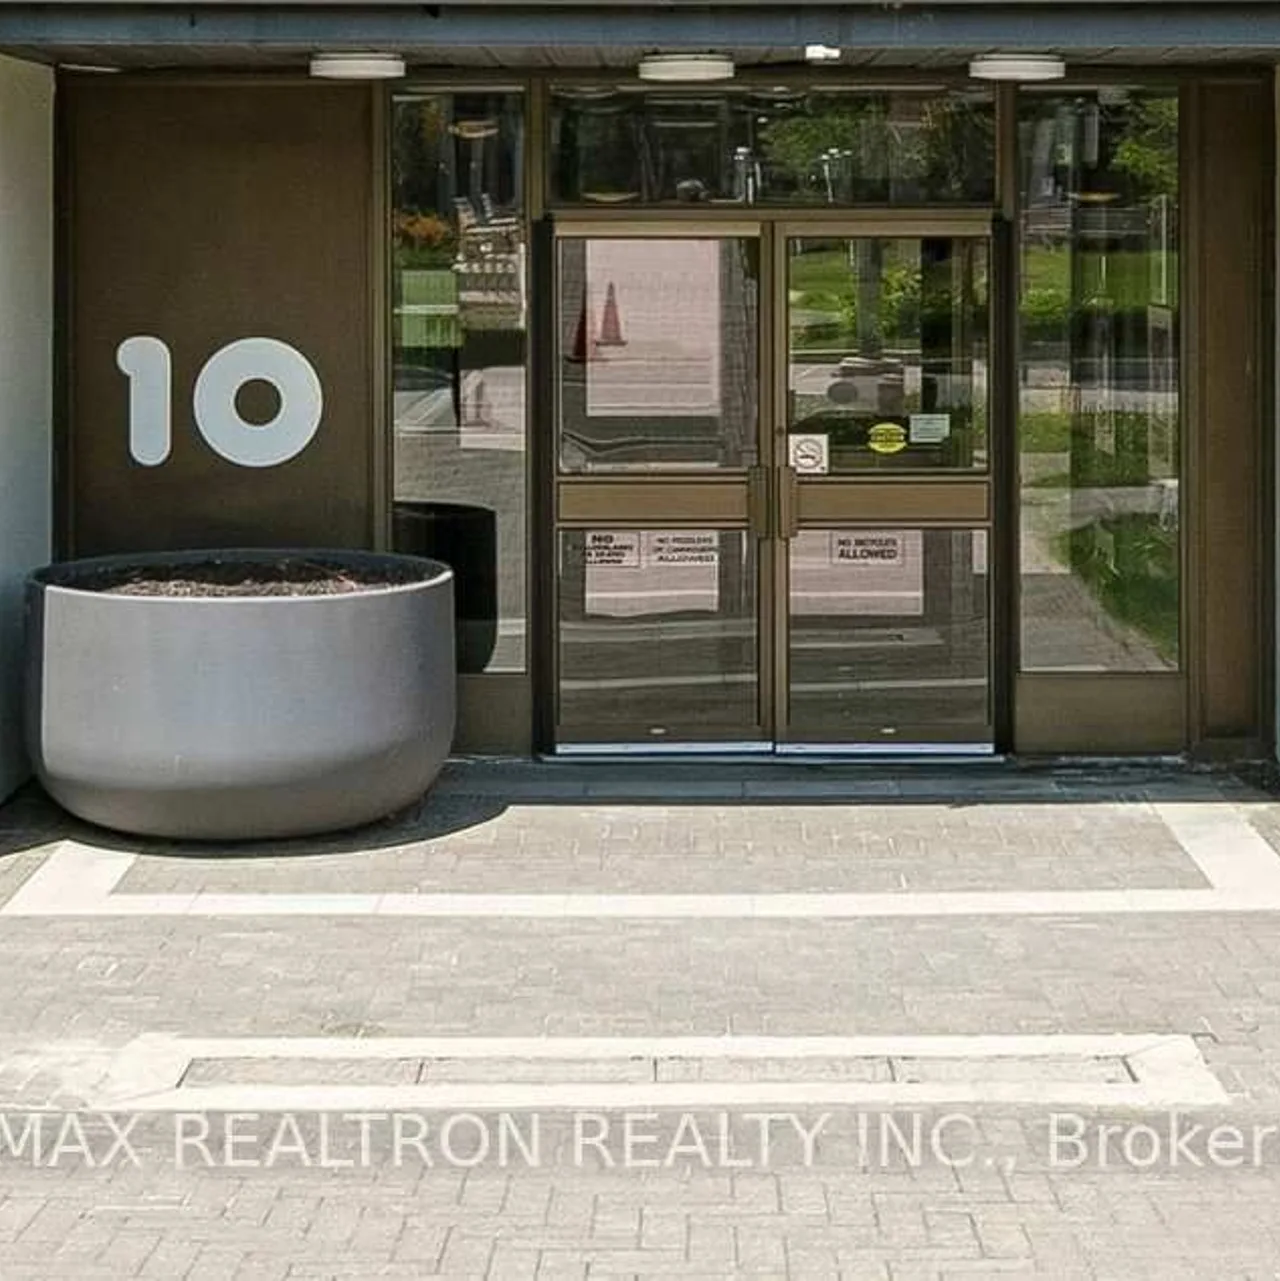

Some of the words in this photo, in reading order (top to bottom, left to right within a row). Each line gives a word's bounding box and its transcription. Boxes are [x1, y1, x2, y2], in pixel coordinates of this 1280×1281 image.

[116, 335, 324, 468] 10
[591, 535, 615, 544] NO
[838, 548, 898, 559] ALLOWED
